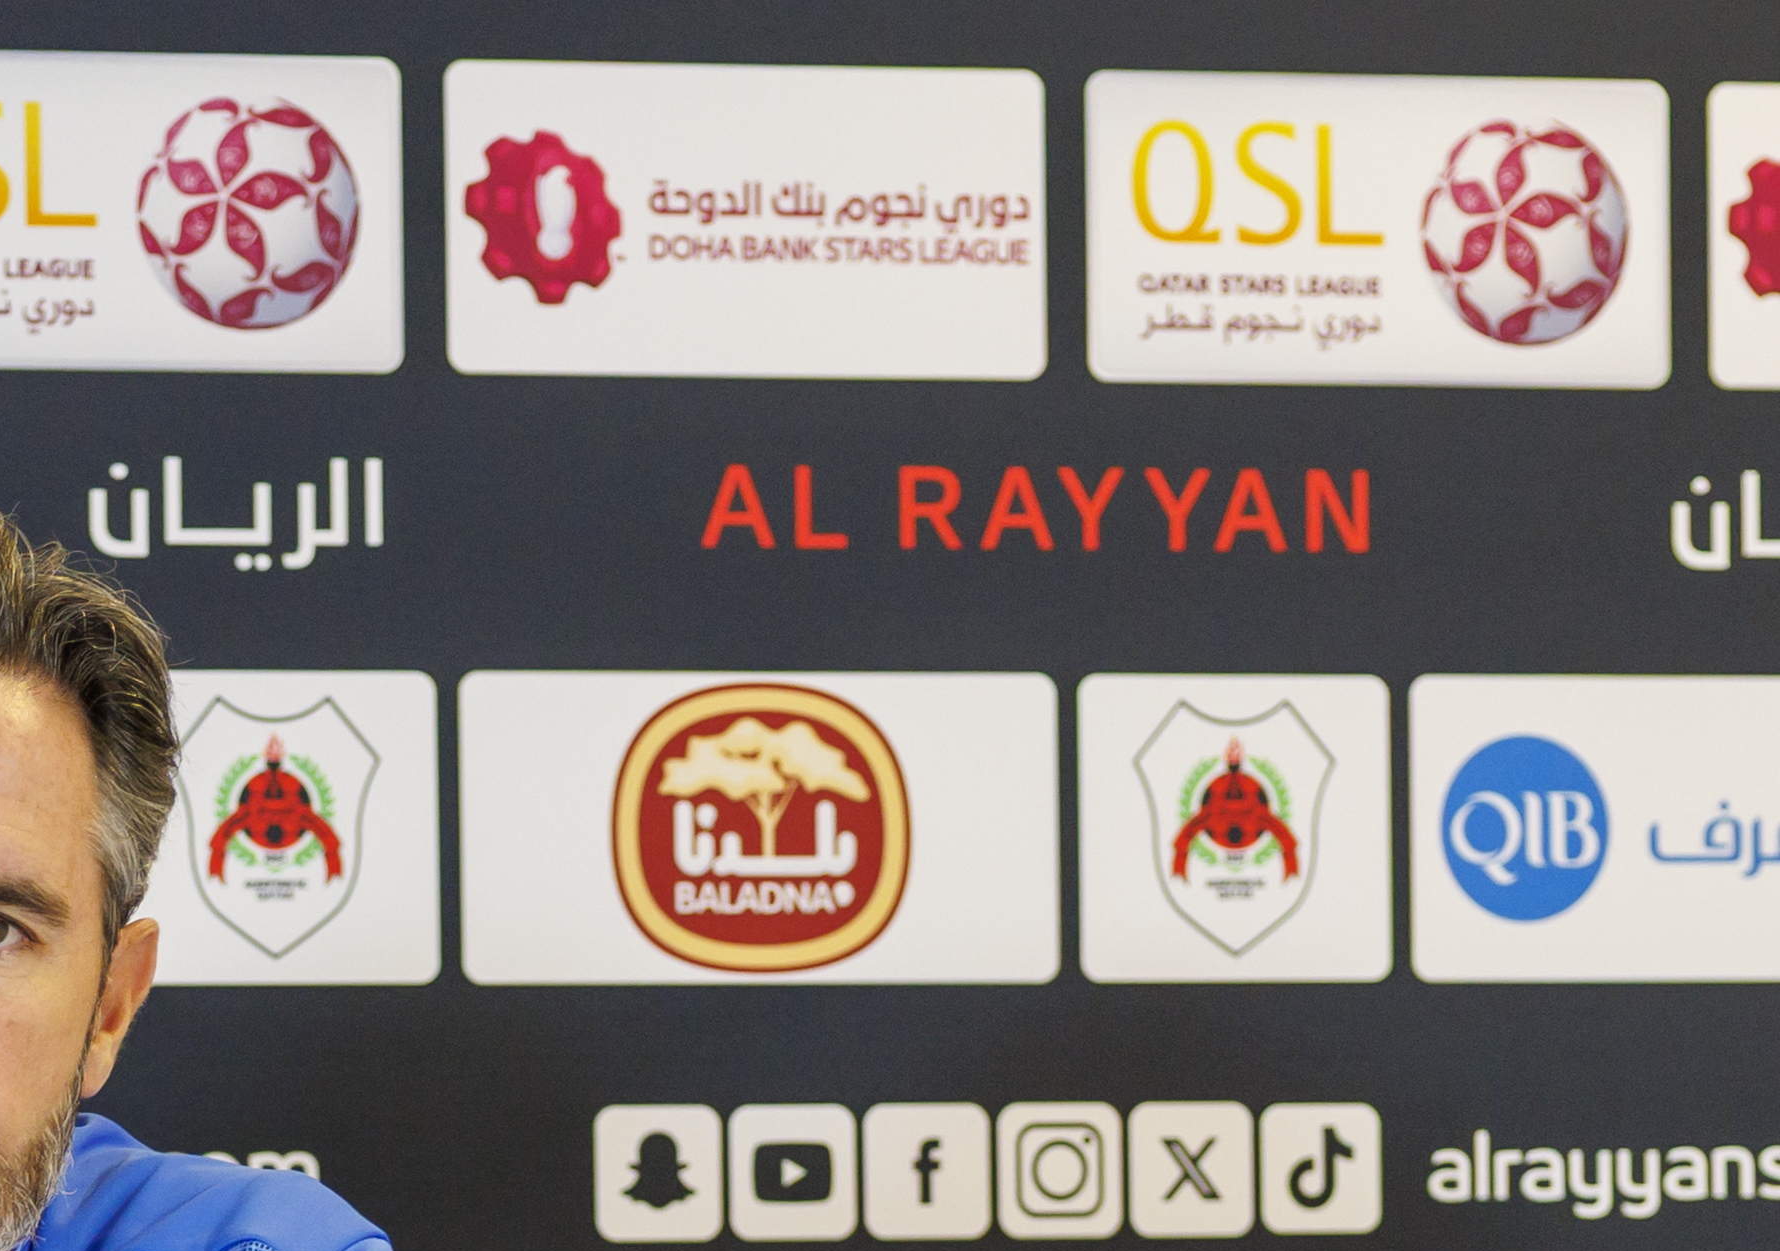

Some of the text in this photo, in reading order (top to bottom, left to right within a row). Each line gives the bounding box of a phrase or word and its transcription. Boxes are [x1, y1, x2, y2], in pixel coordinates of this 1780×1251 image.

[649, 181, 760, 225] الدوحة
[1132, 120, 1384, 246] QSL
[835, 184, 925, 229] نجوم
[936, 195, 1029, 233] دوري
[5, 259, 91, 279] LEAGUE
[649, 234, 1027, 265] DOHA BANK STARS LEAGUE
[1142, 275, 1208, 293] QATAR
[1221, 276, 1285, 294] STARS
[88, 456, 384, 570] الريان
[702, 464, 1369, 553] AL RAYYAN
[1449, 791, 1600, 885] QIB
[673, 880, 838, 916] BALADNA
[1428, 1129, 1780, 1219] alrayyans
